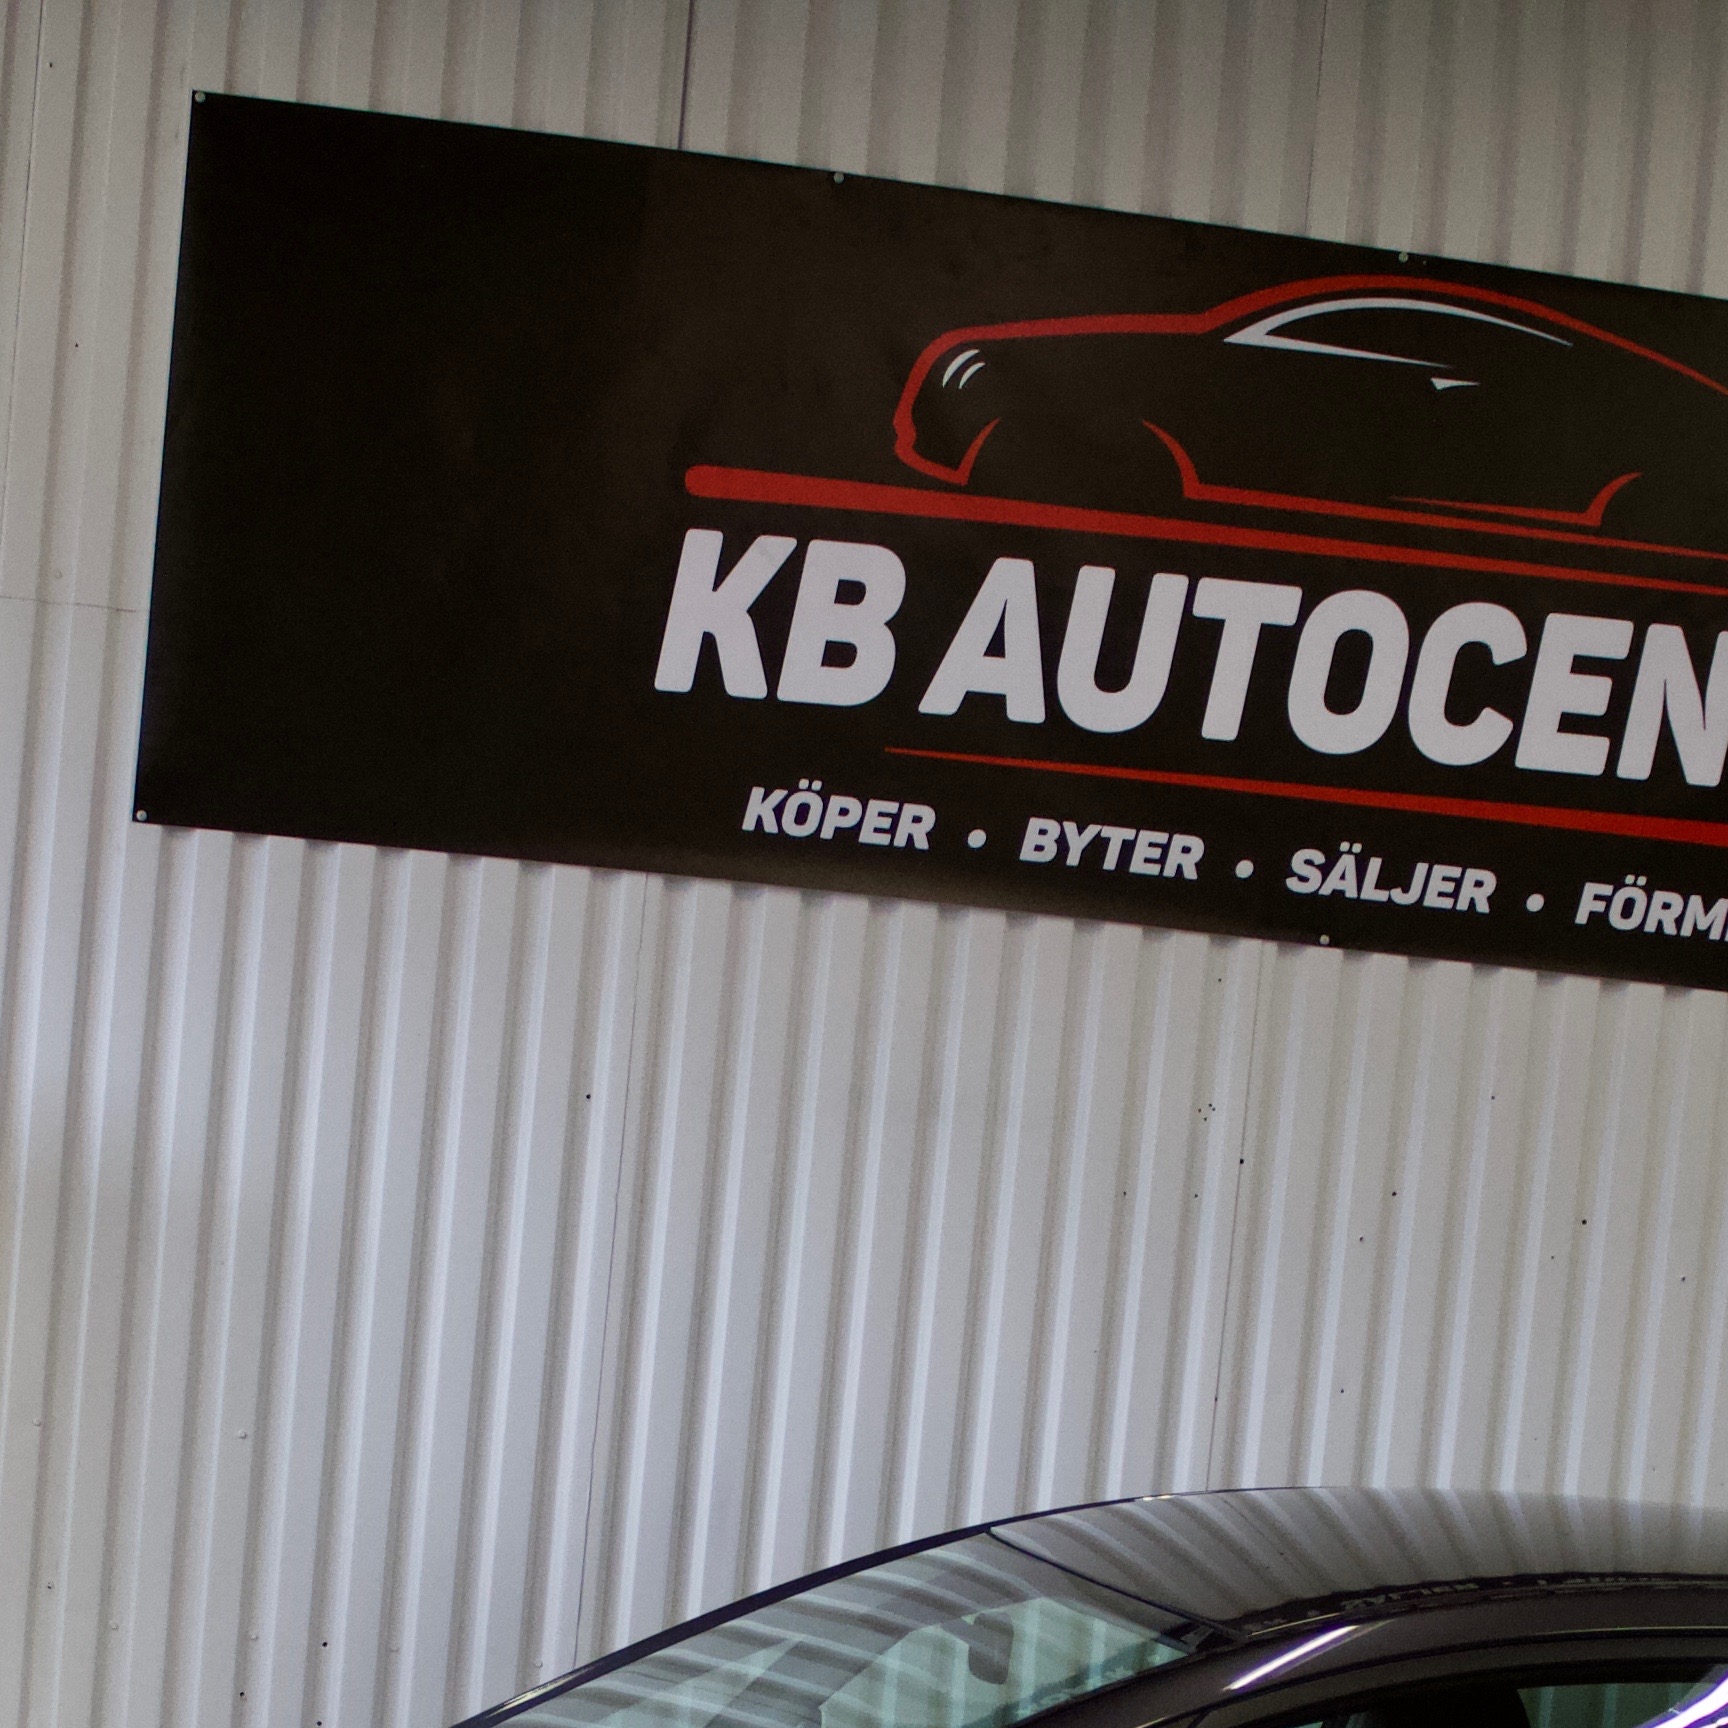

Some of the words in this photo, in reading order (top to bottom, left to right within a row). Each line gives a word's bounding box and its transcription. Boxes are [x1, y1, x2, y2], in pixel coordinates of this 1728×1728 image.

[654, 528, 907, 707] KB
[741, 778, 936, 850] KÖPER
[1019, 816, 1205, 880] BYTER
[1285, 840, 1497, 914] SÄLJER
